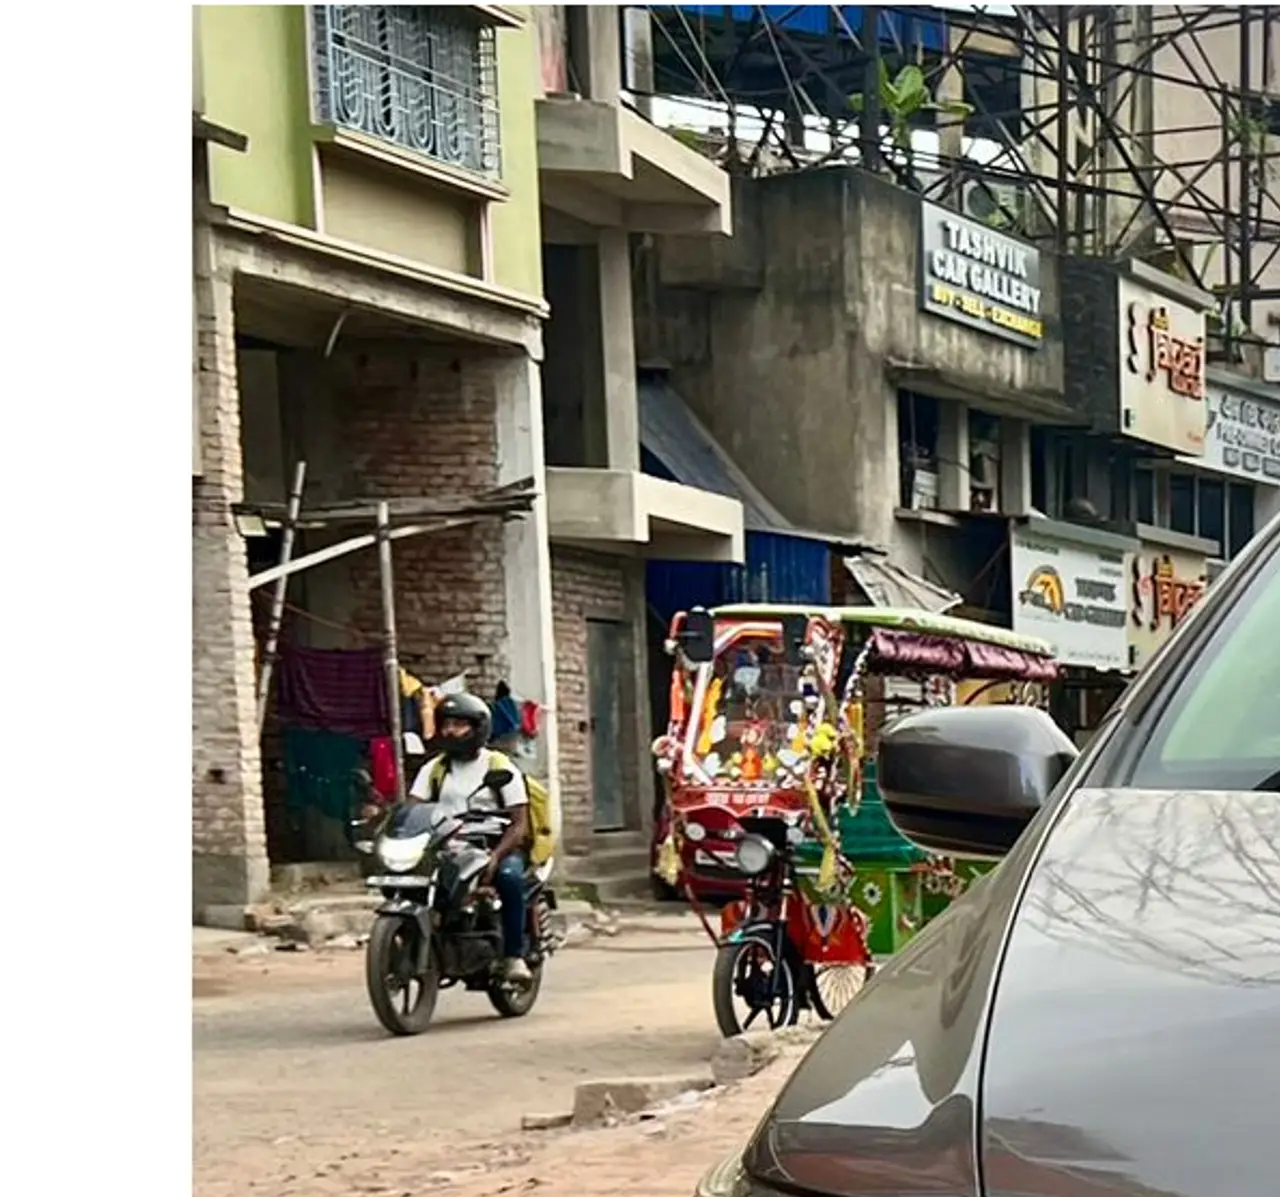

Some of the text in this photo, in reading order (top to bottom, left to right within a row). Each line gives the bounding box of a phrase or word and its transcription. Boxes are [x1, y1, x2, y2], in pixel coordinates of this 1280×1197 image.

[943, 220, 1028, 278] TASHVIK
[930, 248, 1041, 314] CAR GALLERY
